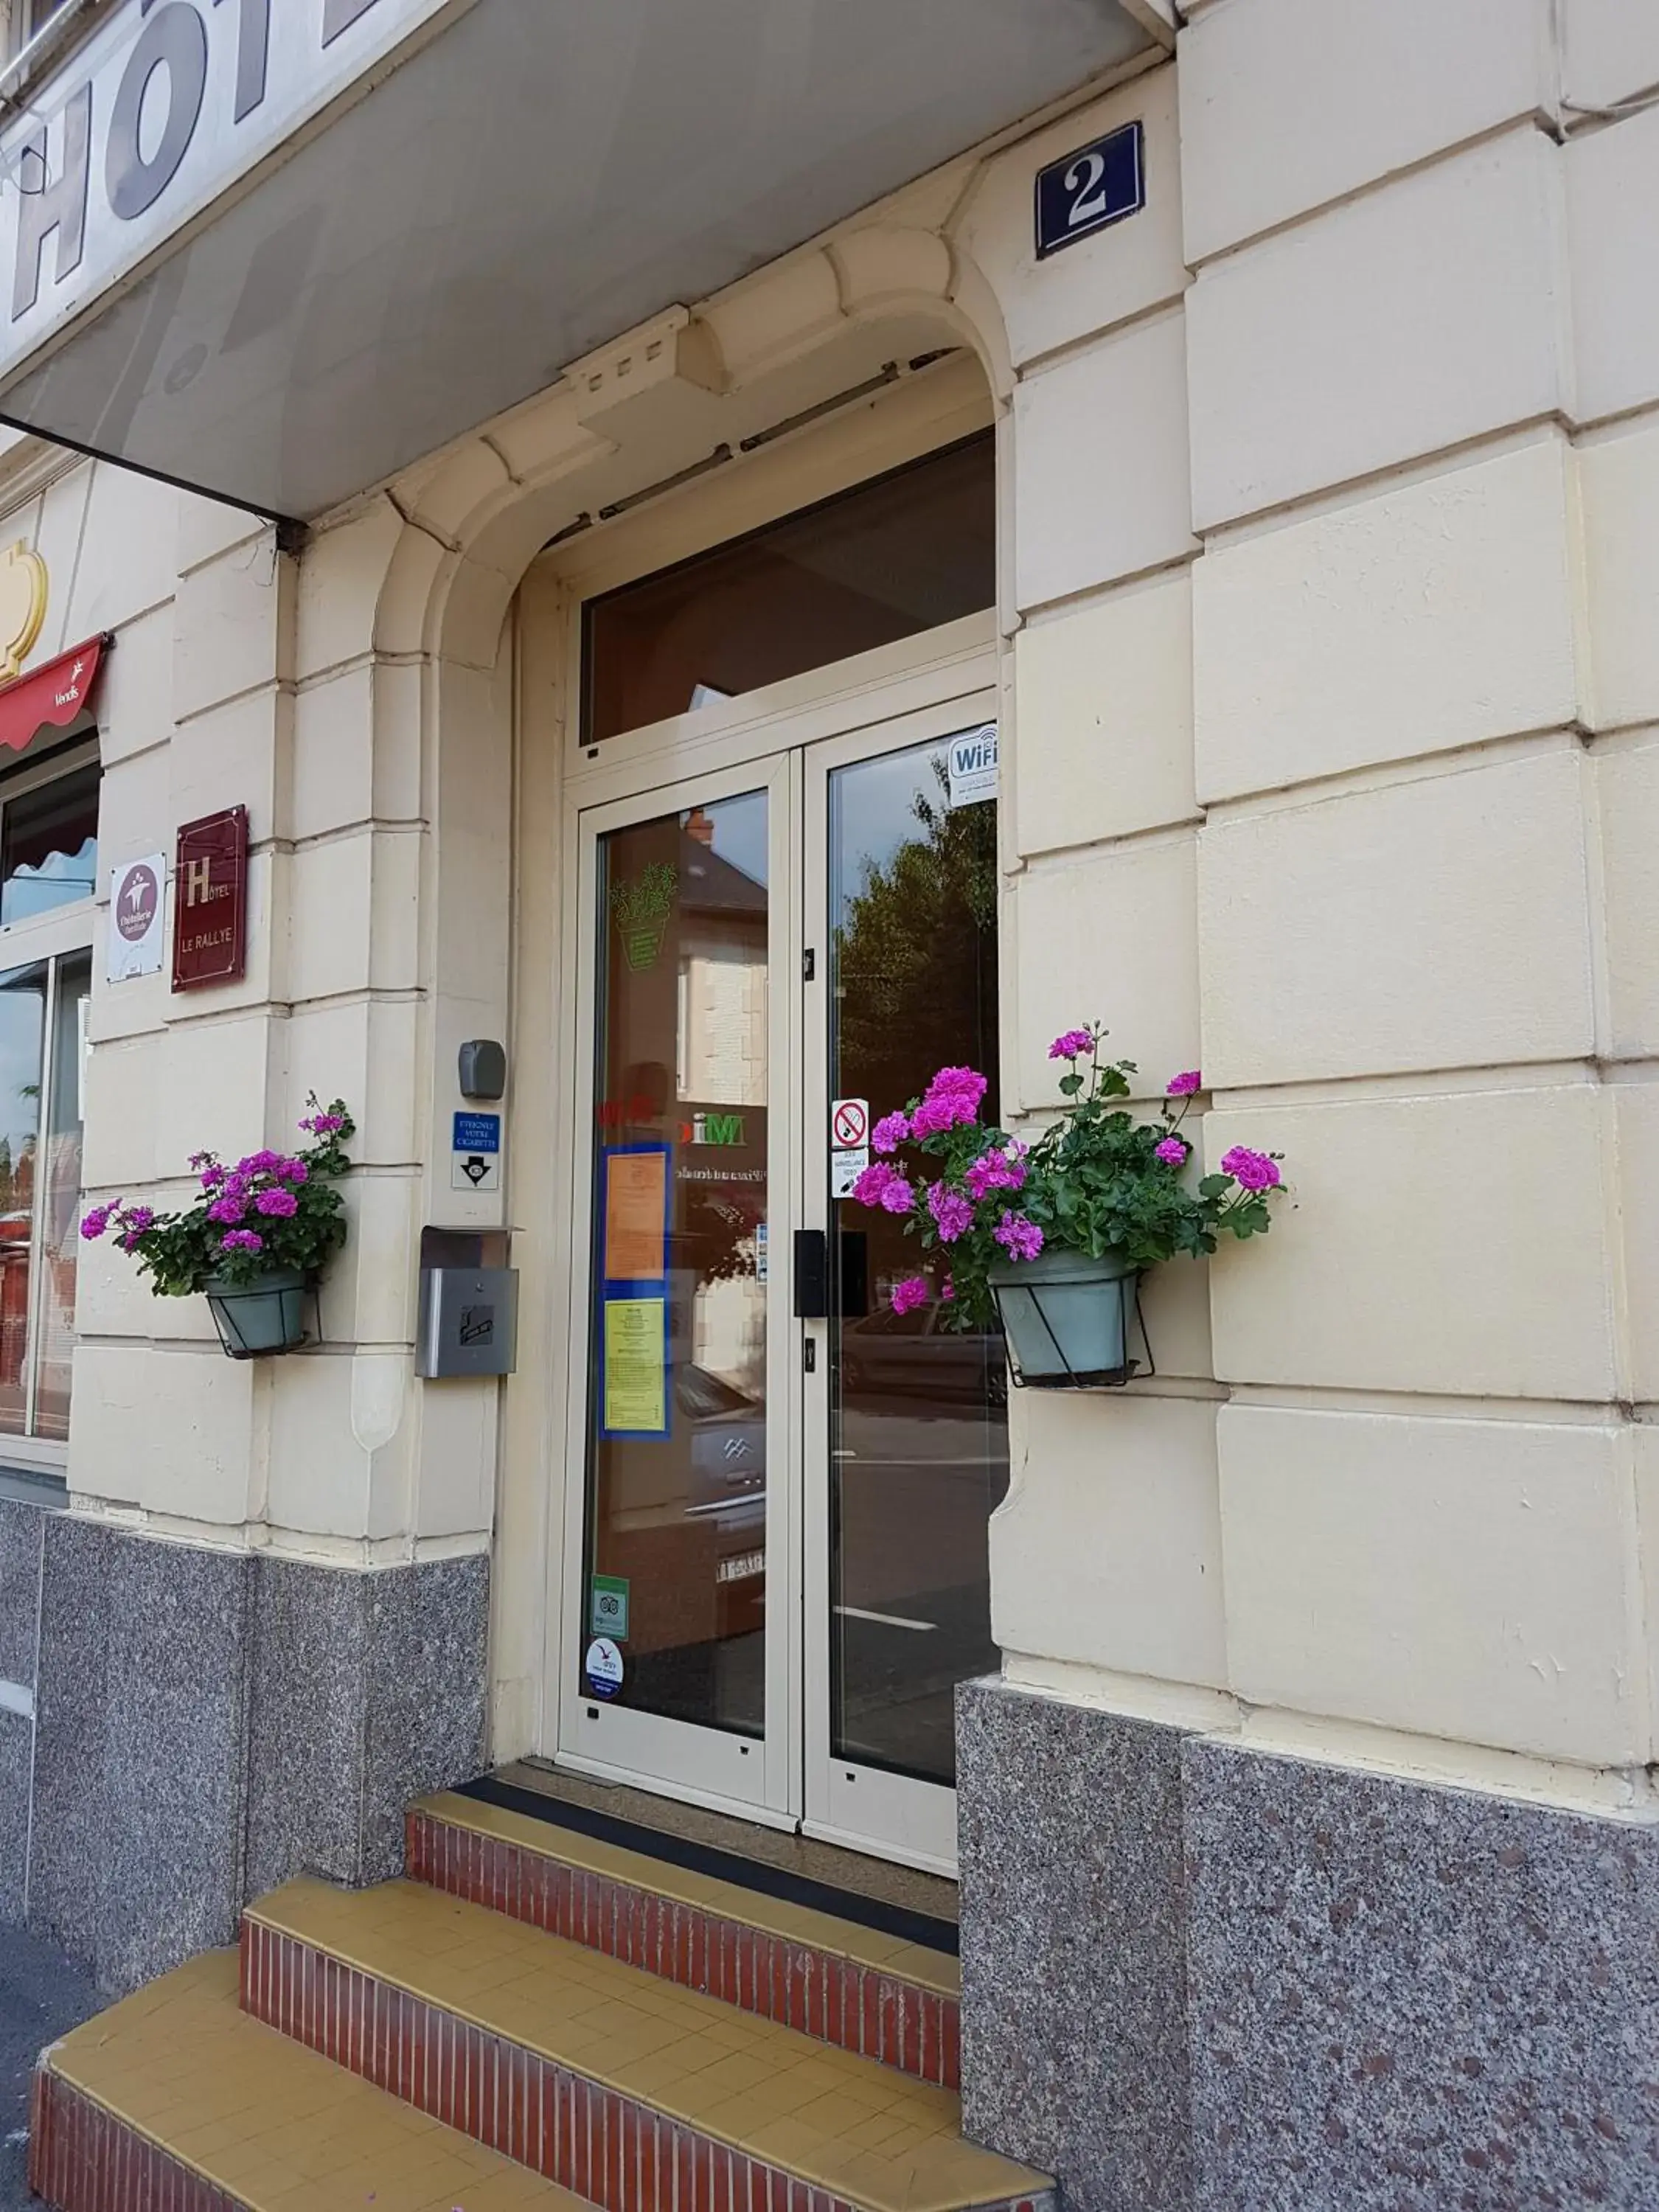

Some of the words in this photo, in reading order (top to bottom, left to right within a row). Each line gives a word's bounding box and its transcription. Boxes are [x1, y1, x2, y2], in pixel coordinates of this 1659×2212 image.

[1065, 153, 1106, 226] 2
[956, 740, 997, 772] WiFi
[181, 938, 193, 953] LE
[195, 927, 233, 949] RALLYE
